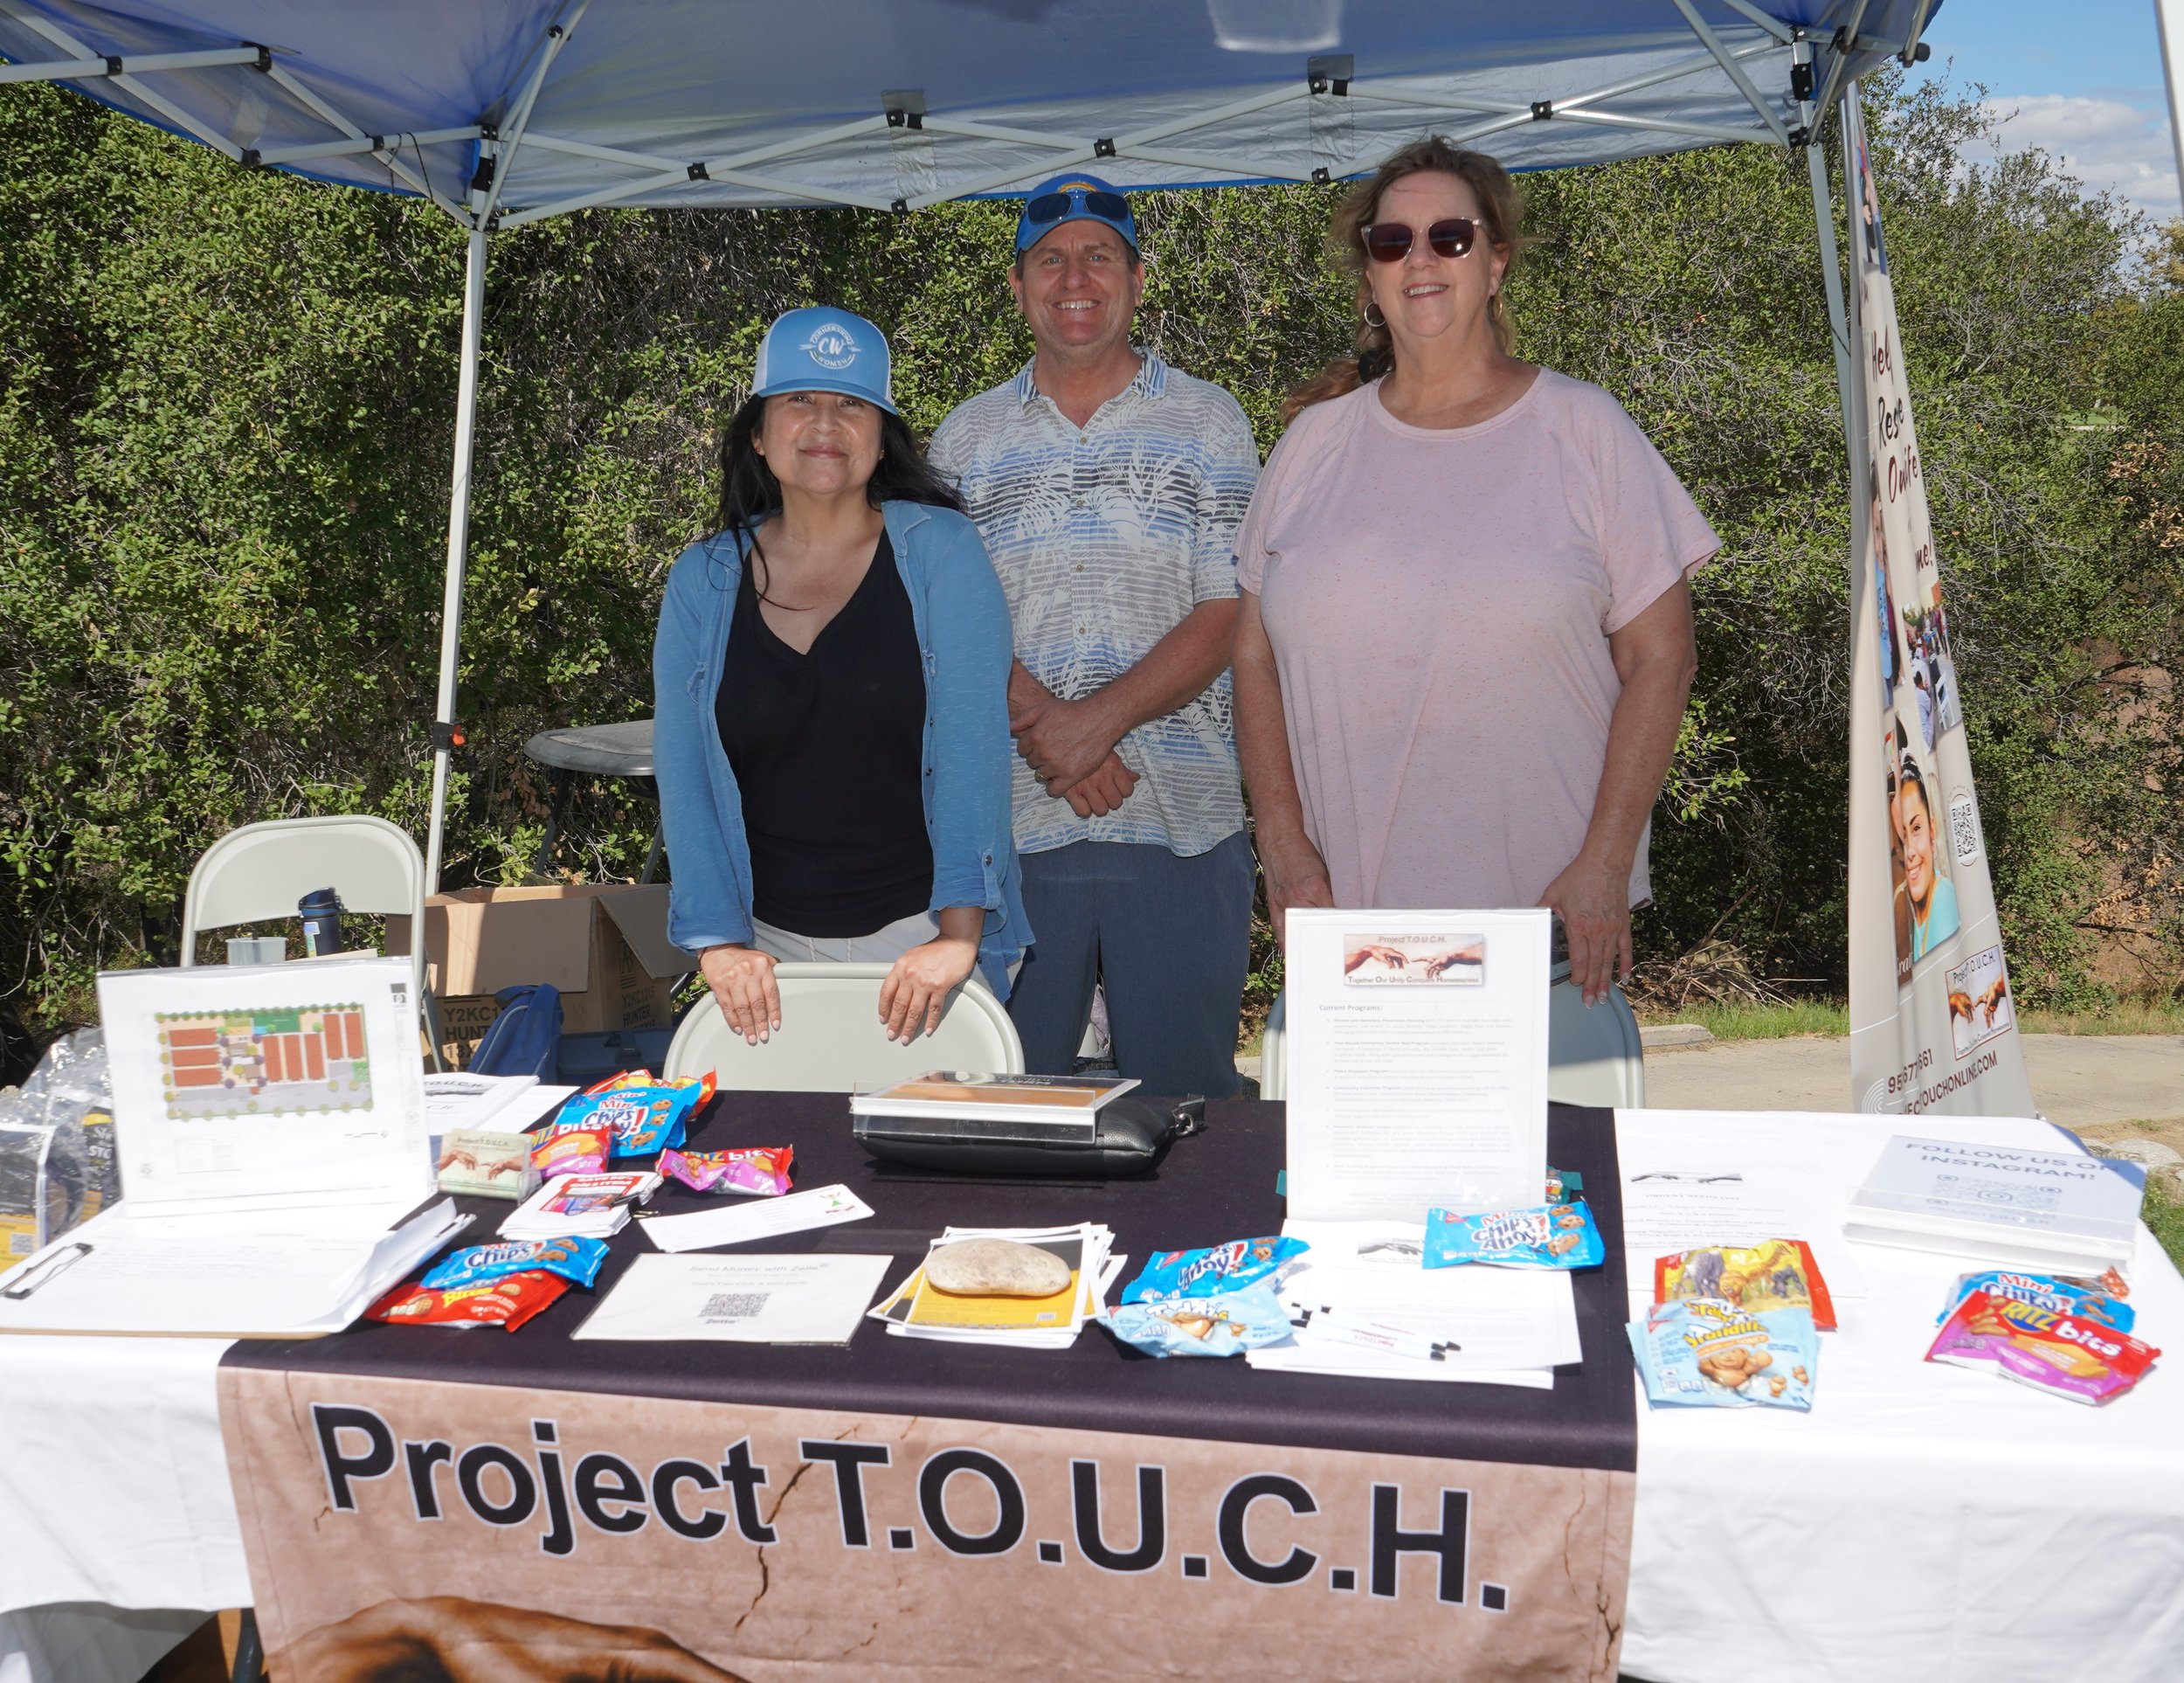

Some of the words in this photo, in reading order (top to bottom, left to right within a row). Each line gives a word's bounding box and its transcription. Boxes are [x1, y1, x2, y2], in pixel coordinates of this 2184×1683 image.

[818, 337, 846, 356] CW
[818, 357, 848, 368] WOMEN
[1378, 936, 1406, 945] Project
[1348, 975, 1374, 986] Together
[1375, 975, 1388, 984] Our
[1389, 975, 1406, 986] Unity
[444, 1006, 499, 1023] Y2KC1
[1347, 1004, 1383, 1013] Programs:
[1905, 1142, 2023, 1162] FOLLOW
[2030, 1154, 2065, 1167] US
[2081, 1160, 2120, 1174] ON
[1920, 1154, 2097, 1181] INSTAGRAM!
[1473, 1216, 1534, 1243] Chips
[1999, 1273, 2053, 1294] Mini
[1999, 1300, 2063, 1333] RITZ
[2055, 1320, 2123, 1357] bits
[308, 1401, 779, 1558] Project
[798, 1437, 1509, 1613] T.O.U.C.H.
